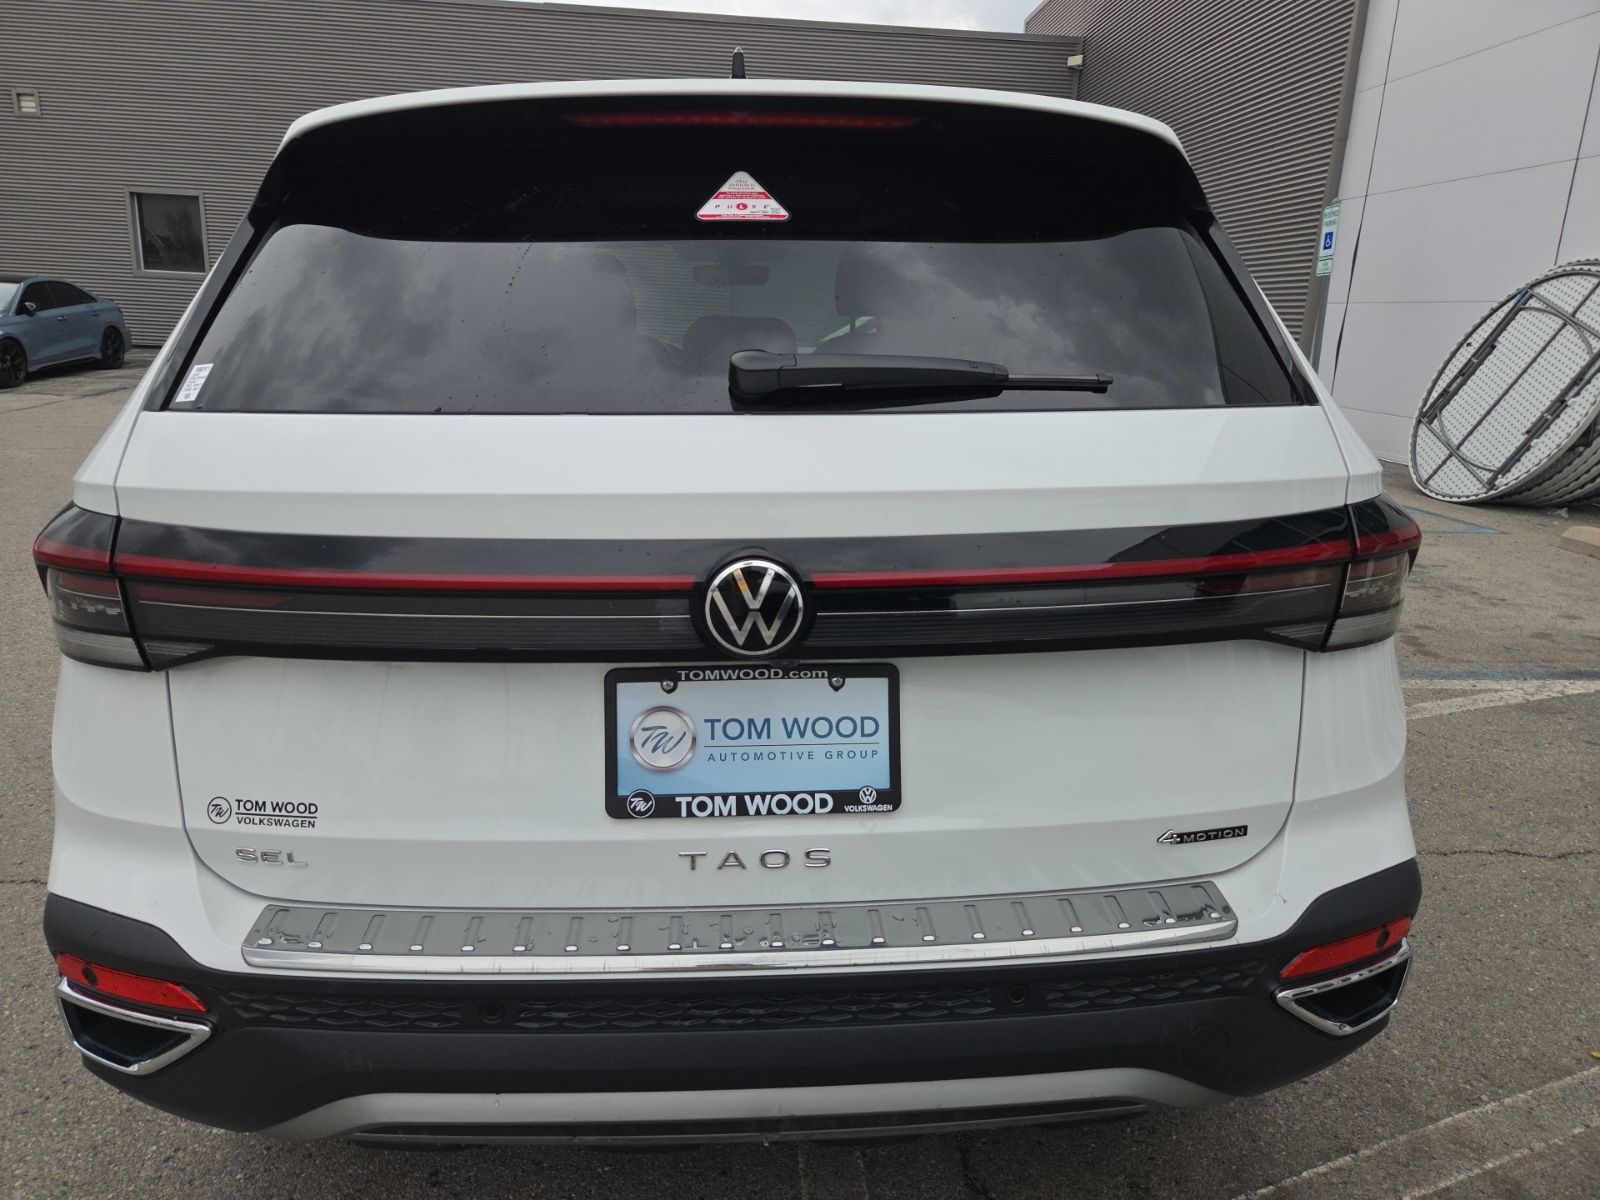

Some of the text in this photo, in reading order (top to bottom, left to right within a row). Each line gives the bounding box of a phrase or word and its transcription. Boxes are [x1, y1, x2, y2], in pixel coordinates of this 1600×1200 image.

[677, 668, 829, 681] TOMWOOD.com
[704, 715, 880, 741] TOM WOOD
[707, 749, 879, 762] AUTOMOTIVE GROUP
[235, 798, 319, 815] TOM WOOD
[675, 792, 834, 818] TOM WOOD
[844, 804, 893, 813] VOLKSWAGEN
[236, 815, 316, 829] VOLKSWAGEN
[235, 847, 310, 868] SEL
[678, 847, 831, 871] TAOS
